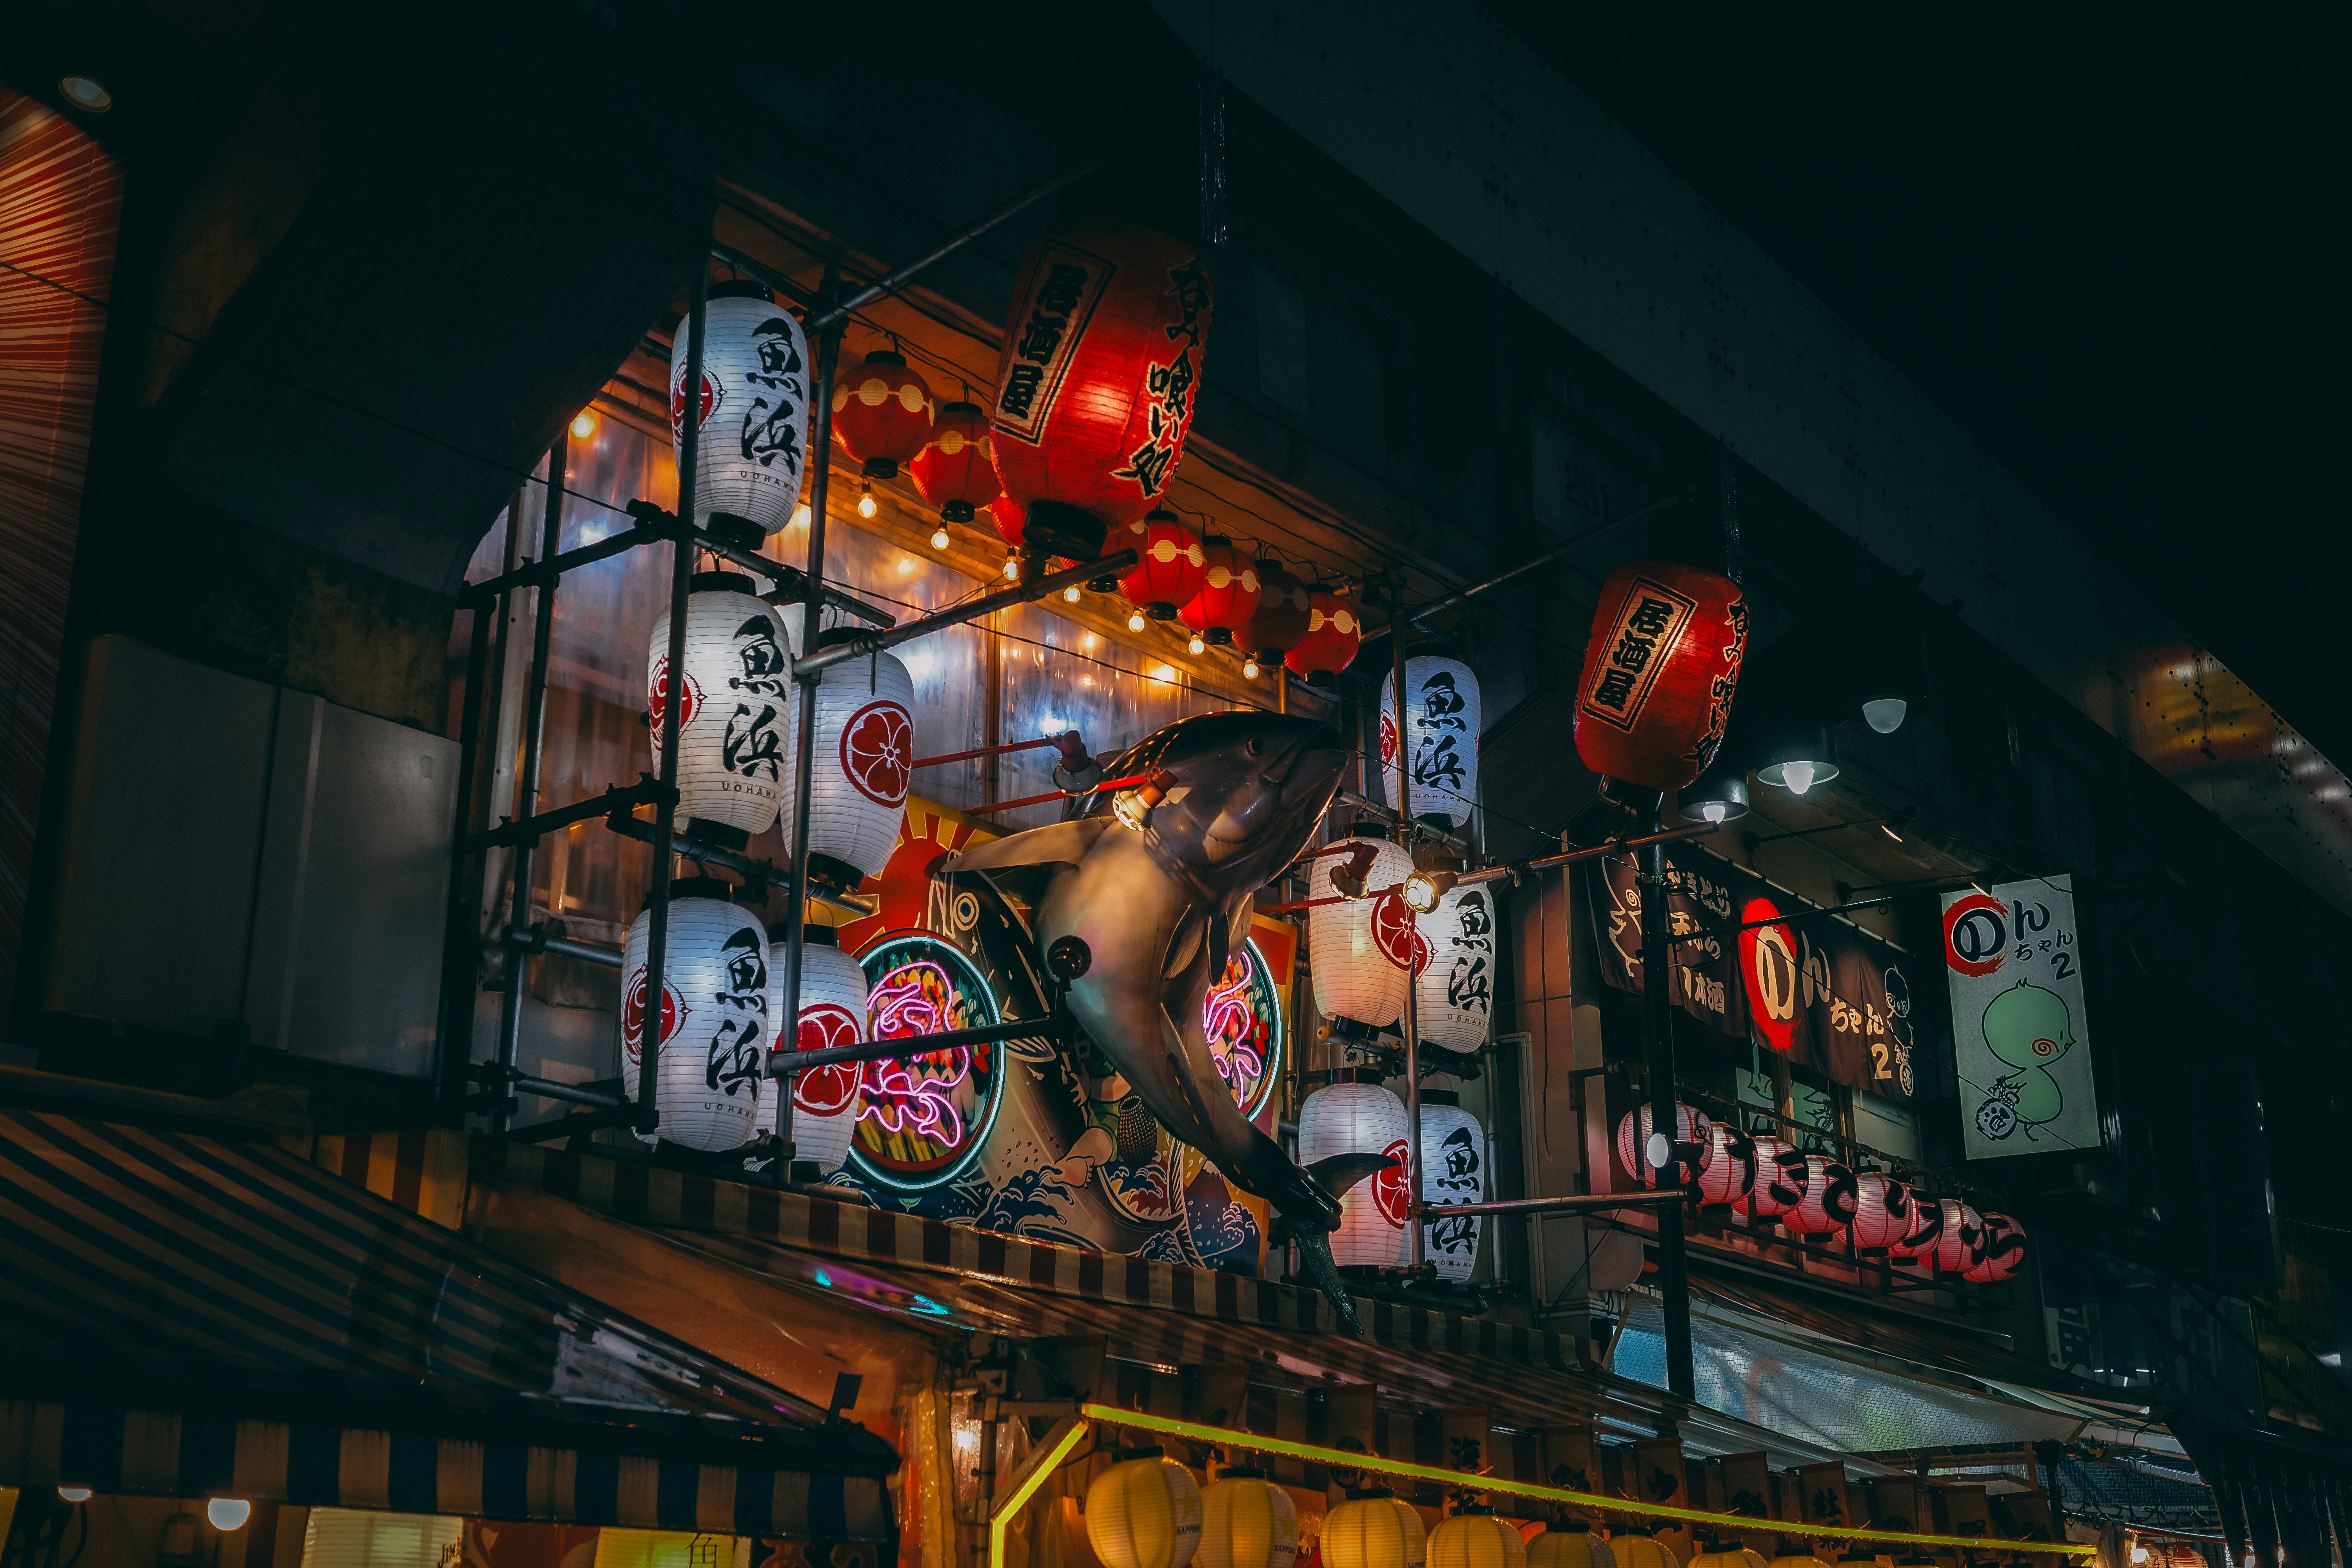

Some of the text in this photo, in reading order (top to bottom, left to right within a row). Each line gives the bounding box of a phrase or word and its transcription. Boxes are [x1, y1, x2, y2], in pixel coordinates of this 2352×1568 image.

[741, 317, 803, 475] 魚浜
[1001, 264, 1089, 419] 居酒屋
[740, 471, 794, 493] UOHAMA
[722, 614, 786, 782] 魚浜
[1595, 596, 1674, 711] 居酒屋
[1416, 671, 1467, 790] 魚浜
[721, 782, 777, 800] UOHAMA
[1415, 793, 1461, 803] UOHAMA
[1448, 891, 1492, 1014] 魚浜
[706, 927, 767, 1103] 魚浜
[1448, 1014, 1486, 1028] UOHAMA
[704, 1102, 755, 1120] UOHAMA
[1432, 1127, 1480, 1255] 魚浜
[684, 1532, 718, 1568] 角
